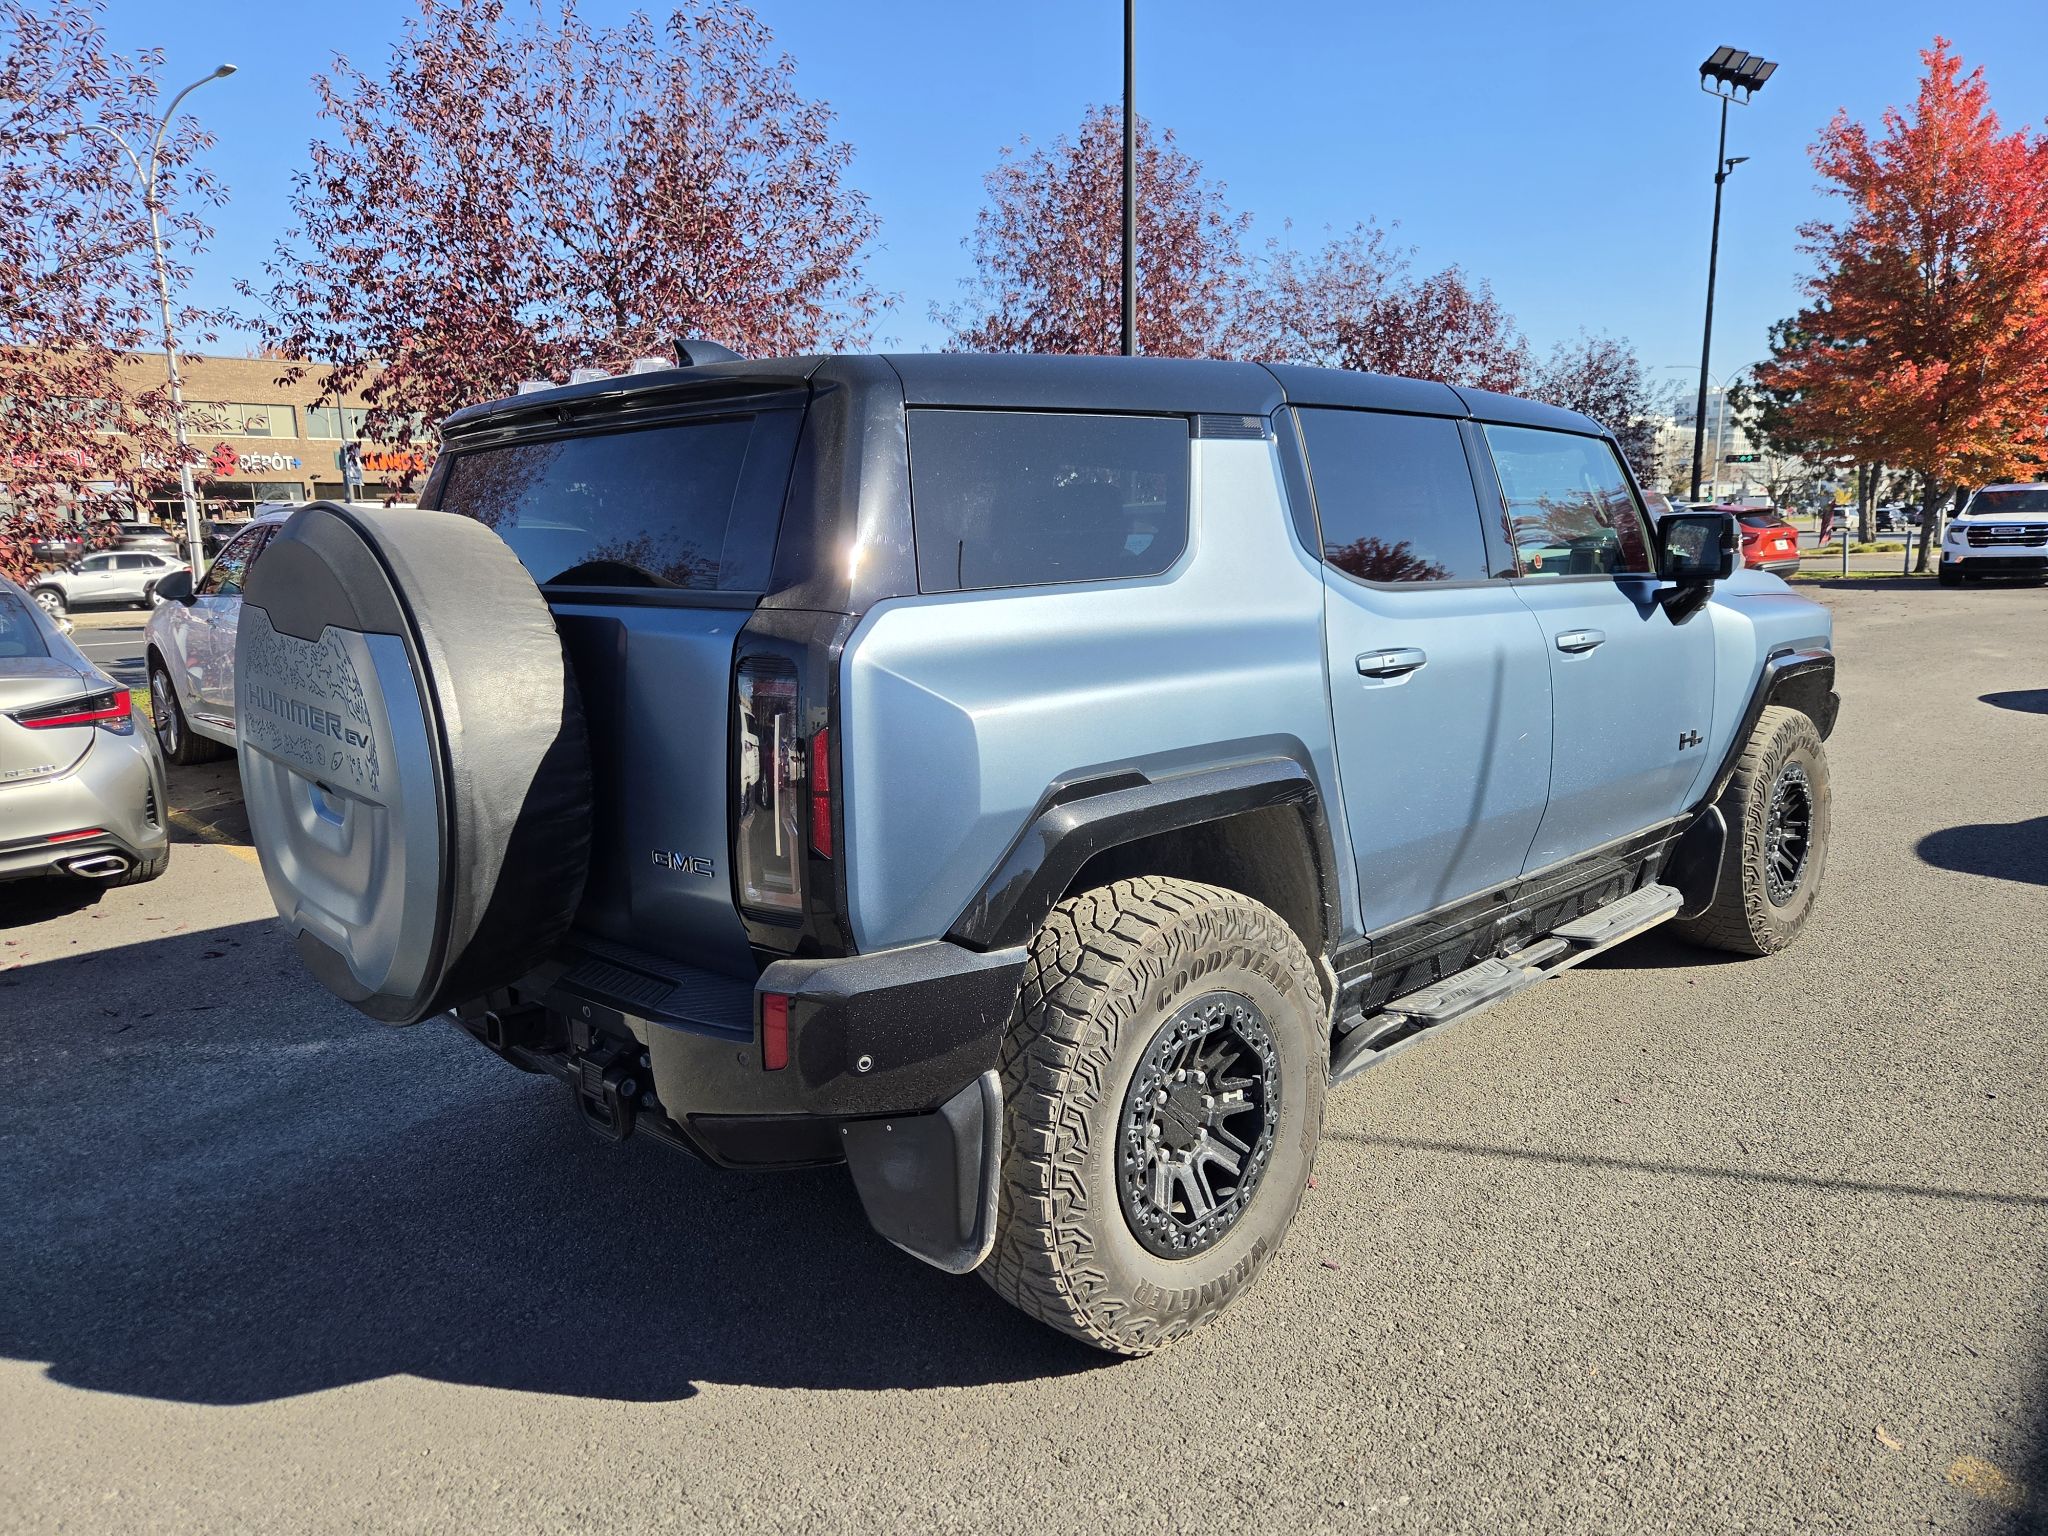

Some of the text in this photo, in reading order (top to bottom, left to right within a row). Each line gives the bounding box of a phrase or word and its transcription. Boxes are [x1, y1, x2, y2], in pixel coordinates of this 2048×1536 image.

[247, 682, 370, 749] HUMMER EV
[651, 848, 715, 878] GMC
[1156, 945, 1294, 1013] GOODYEAR
[1131, 1236, 1268, 1313] WRANGLER
